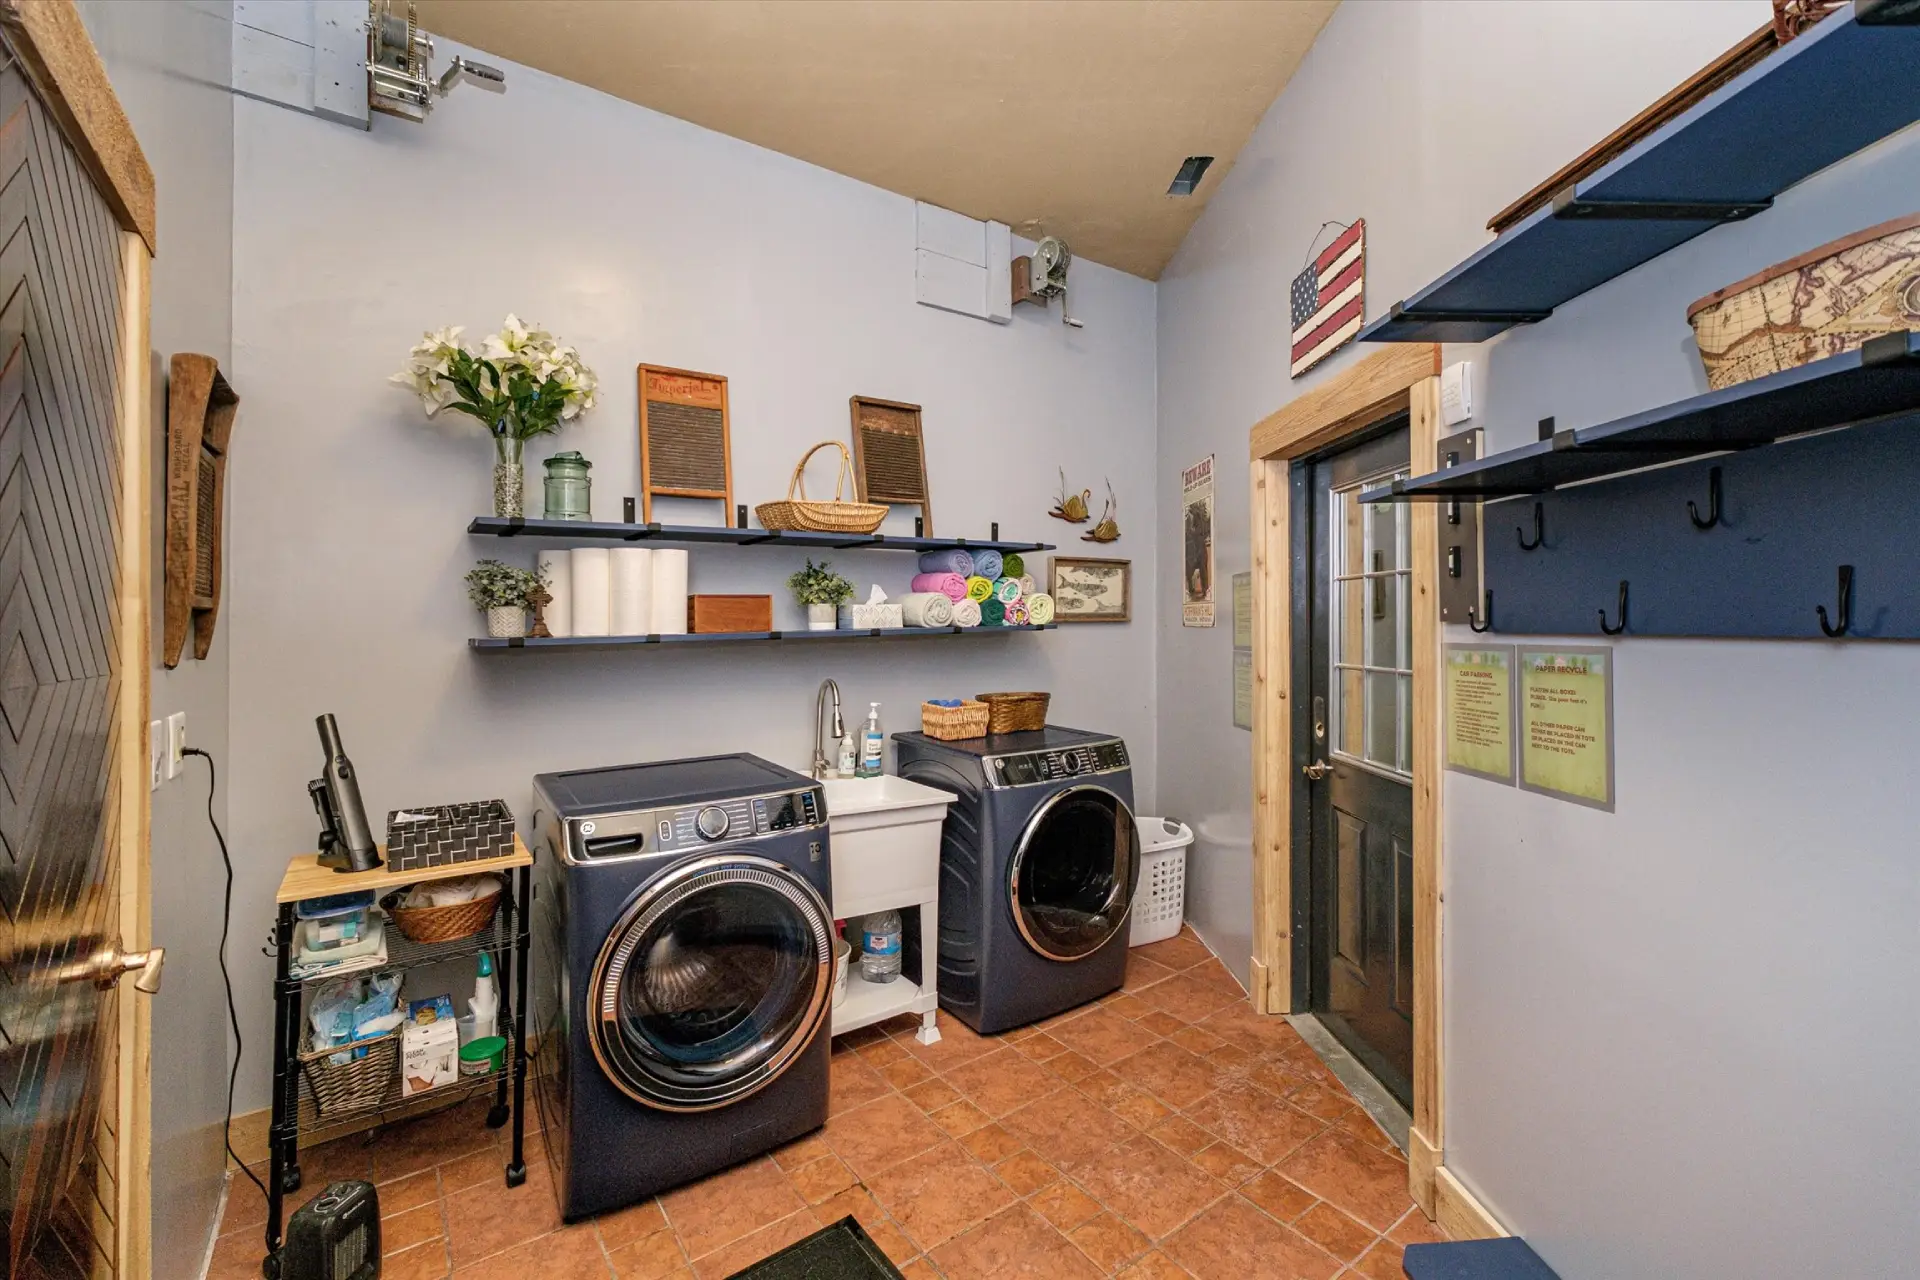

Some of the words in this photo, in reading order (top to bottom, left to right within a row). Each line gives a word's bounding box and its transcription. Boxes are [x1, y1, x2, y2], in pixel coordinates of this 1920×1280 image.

[1184, 458, 1210, 487] BEWARE
[1536, 665, 1555, 673] PAPER
[1557, 666, 1588, 674] RECYCLE
[1554, 731, 1574, 739] PLACED
